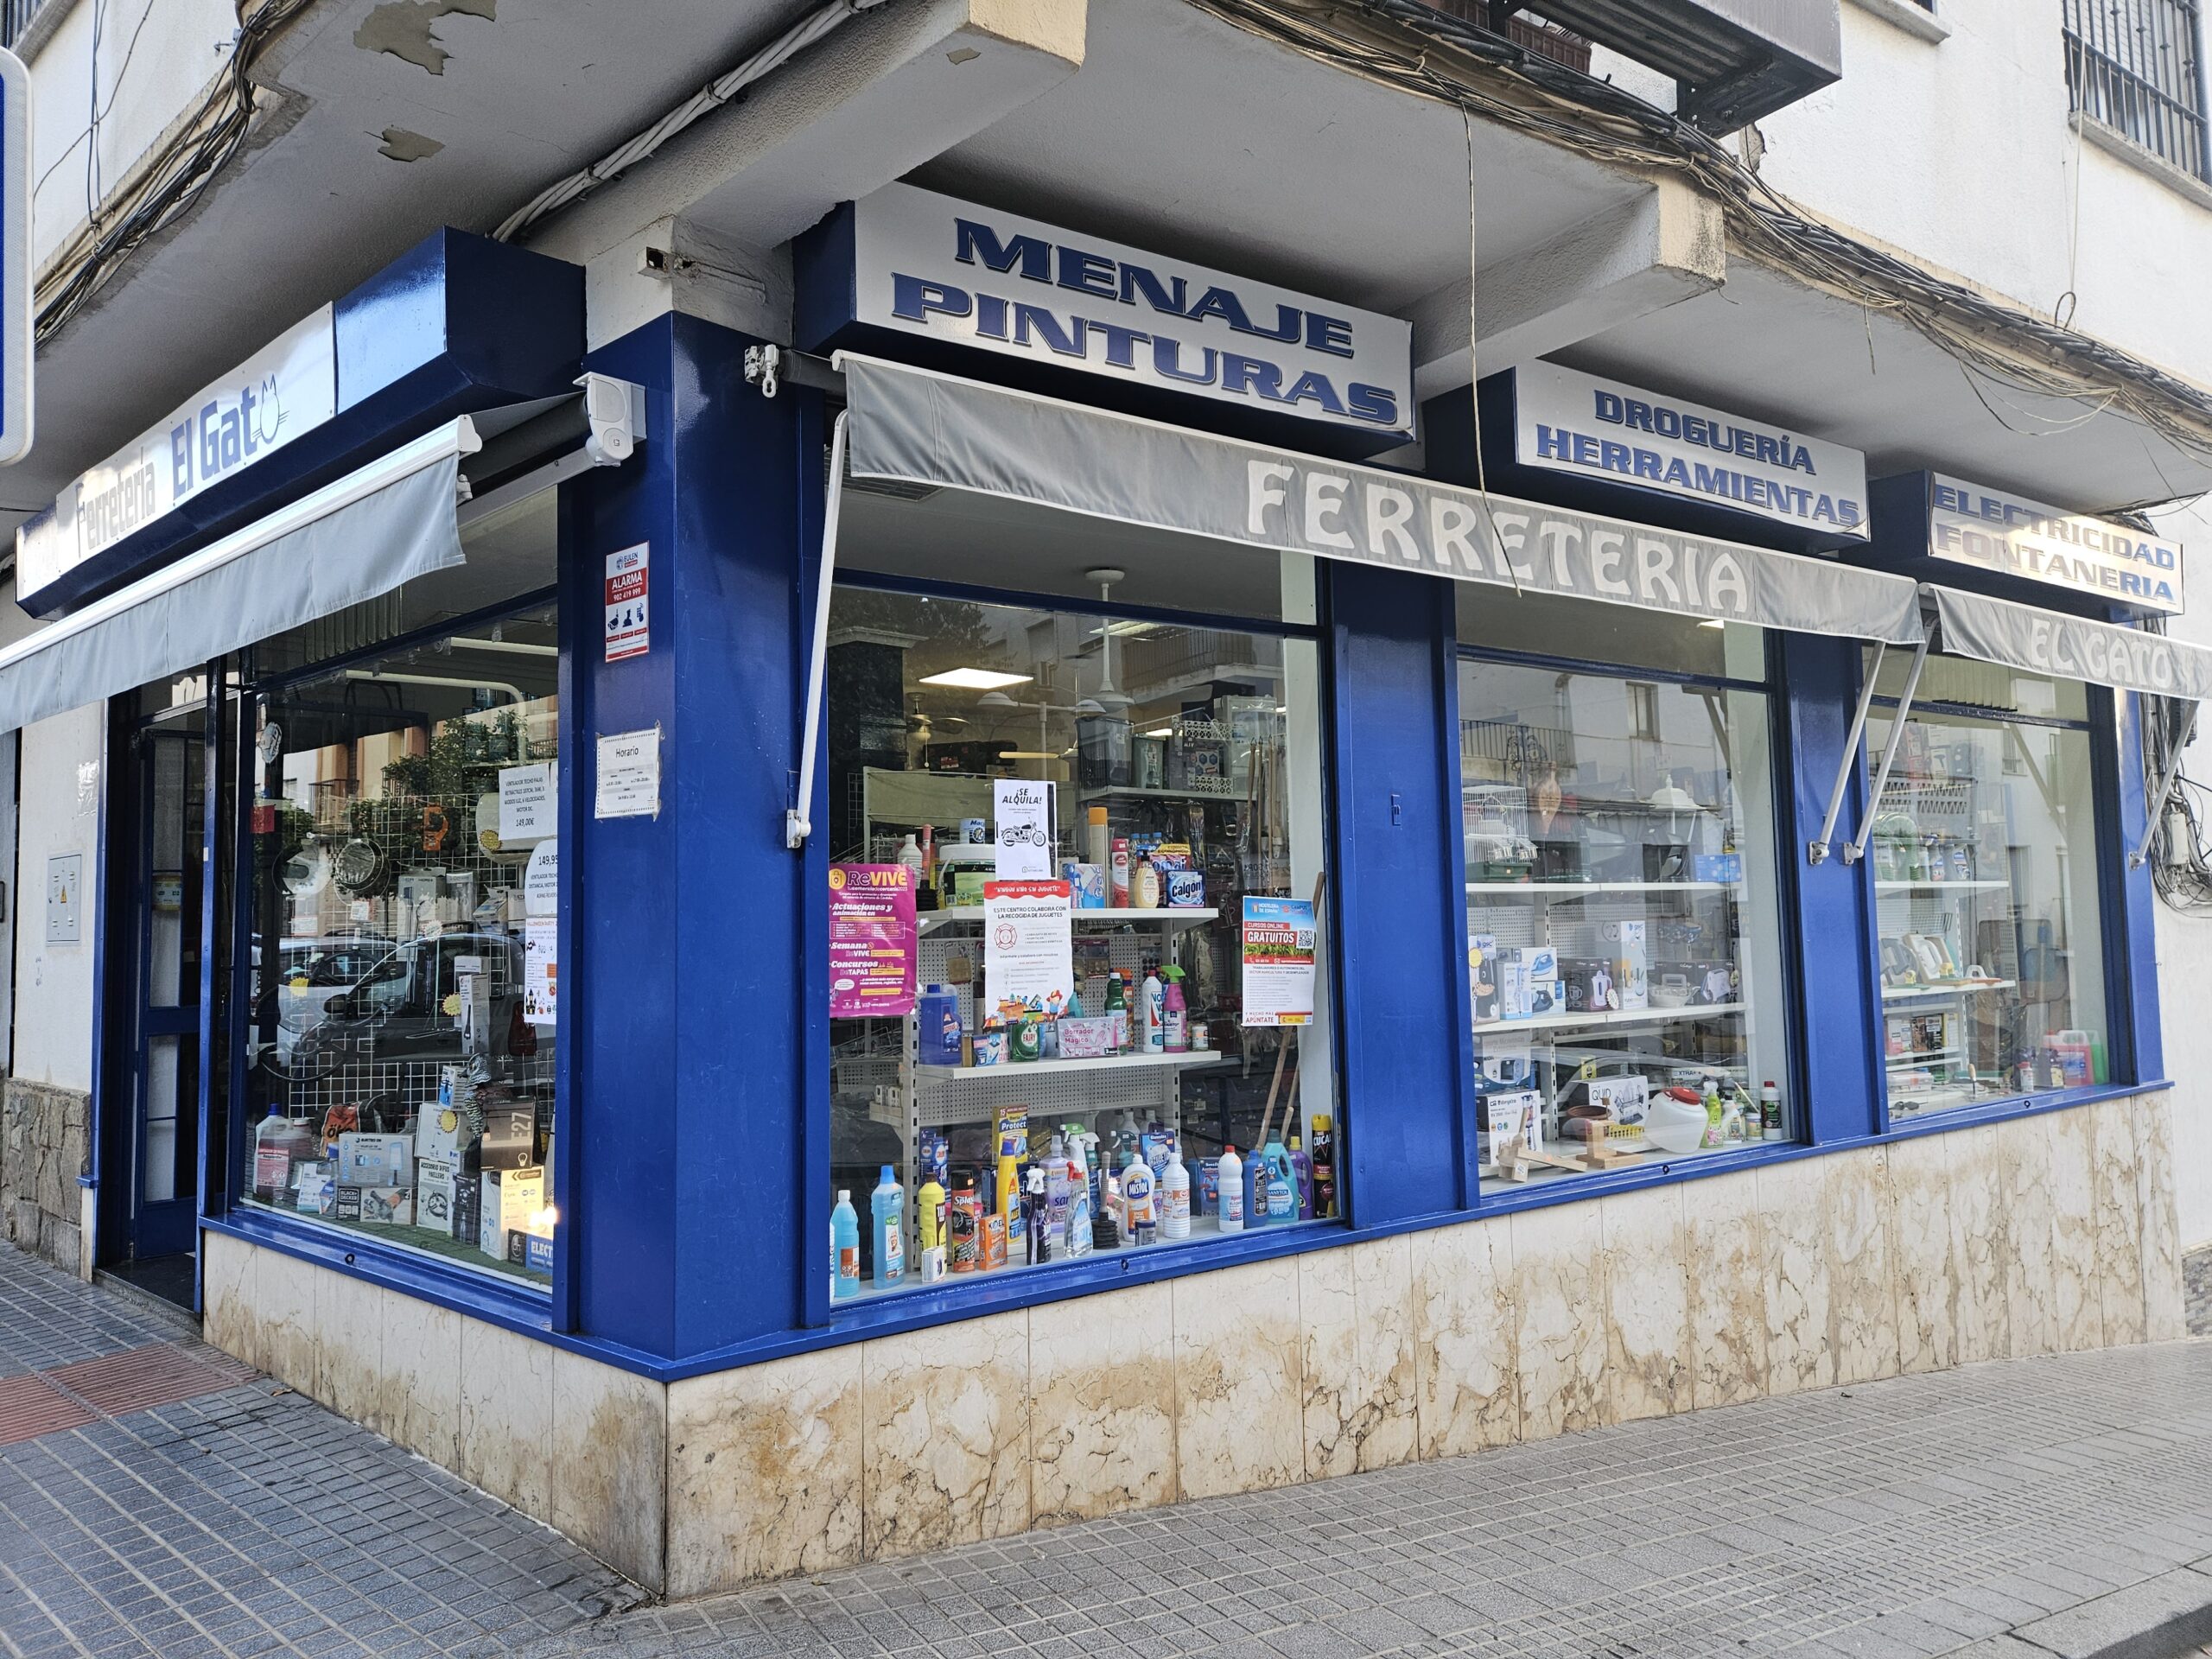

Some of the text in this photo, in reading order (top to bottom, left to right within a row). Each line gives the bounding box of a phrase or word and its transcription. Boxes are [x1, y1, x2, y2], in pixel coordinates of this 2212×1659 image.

[954, 218, 1355, 358] MENAJE
[892, 271, 1398, 426] PINTURAS
[1594, 389, 1817, 476] DROGUERÍA
[171, 417, 194, 501] El
[1536, 423, 1860, 529] HERRAMIENTAS
[1247, 459, 1748, 613] FERRETERIA
[1934, 483, 2175, 571] ELECTRICIDAD
[1936, 523, 2177, 605] FONTANERIA
[612, 570, 643, 590] ALARMA
[613, 593, 623, 601] 902
[2031, 618, 2173, 690] EL GATO
[615, 745, 639, 758] Horario
[1001, 795, 1042, 805] ALQUILA!
[848, 871, 907, 887] ReVIVE
[1172, 880, 1201, 898] Calgon
[832, 903, 886, 912] Actuaciones
[830, 941, 868, 950] Semana
[1248, 931, 1294, 944] GRATUITOS
[511, 1111, 531, 1141] E27
[1001, 1121, 1027, 1130] Protect
[1128, 1181, 1148, 1195] MISTOL
